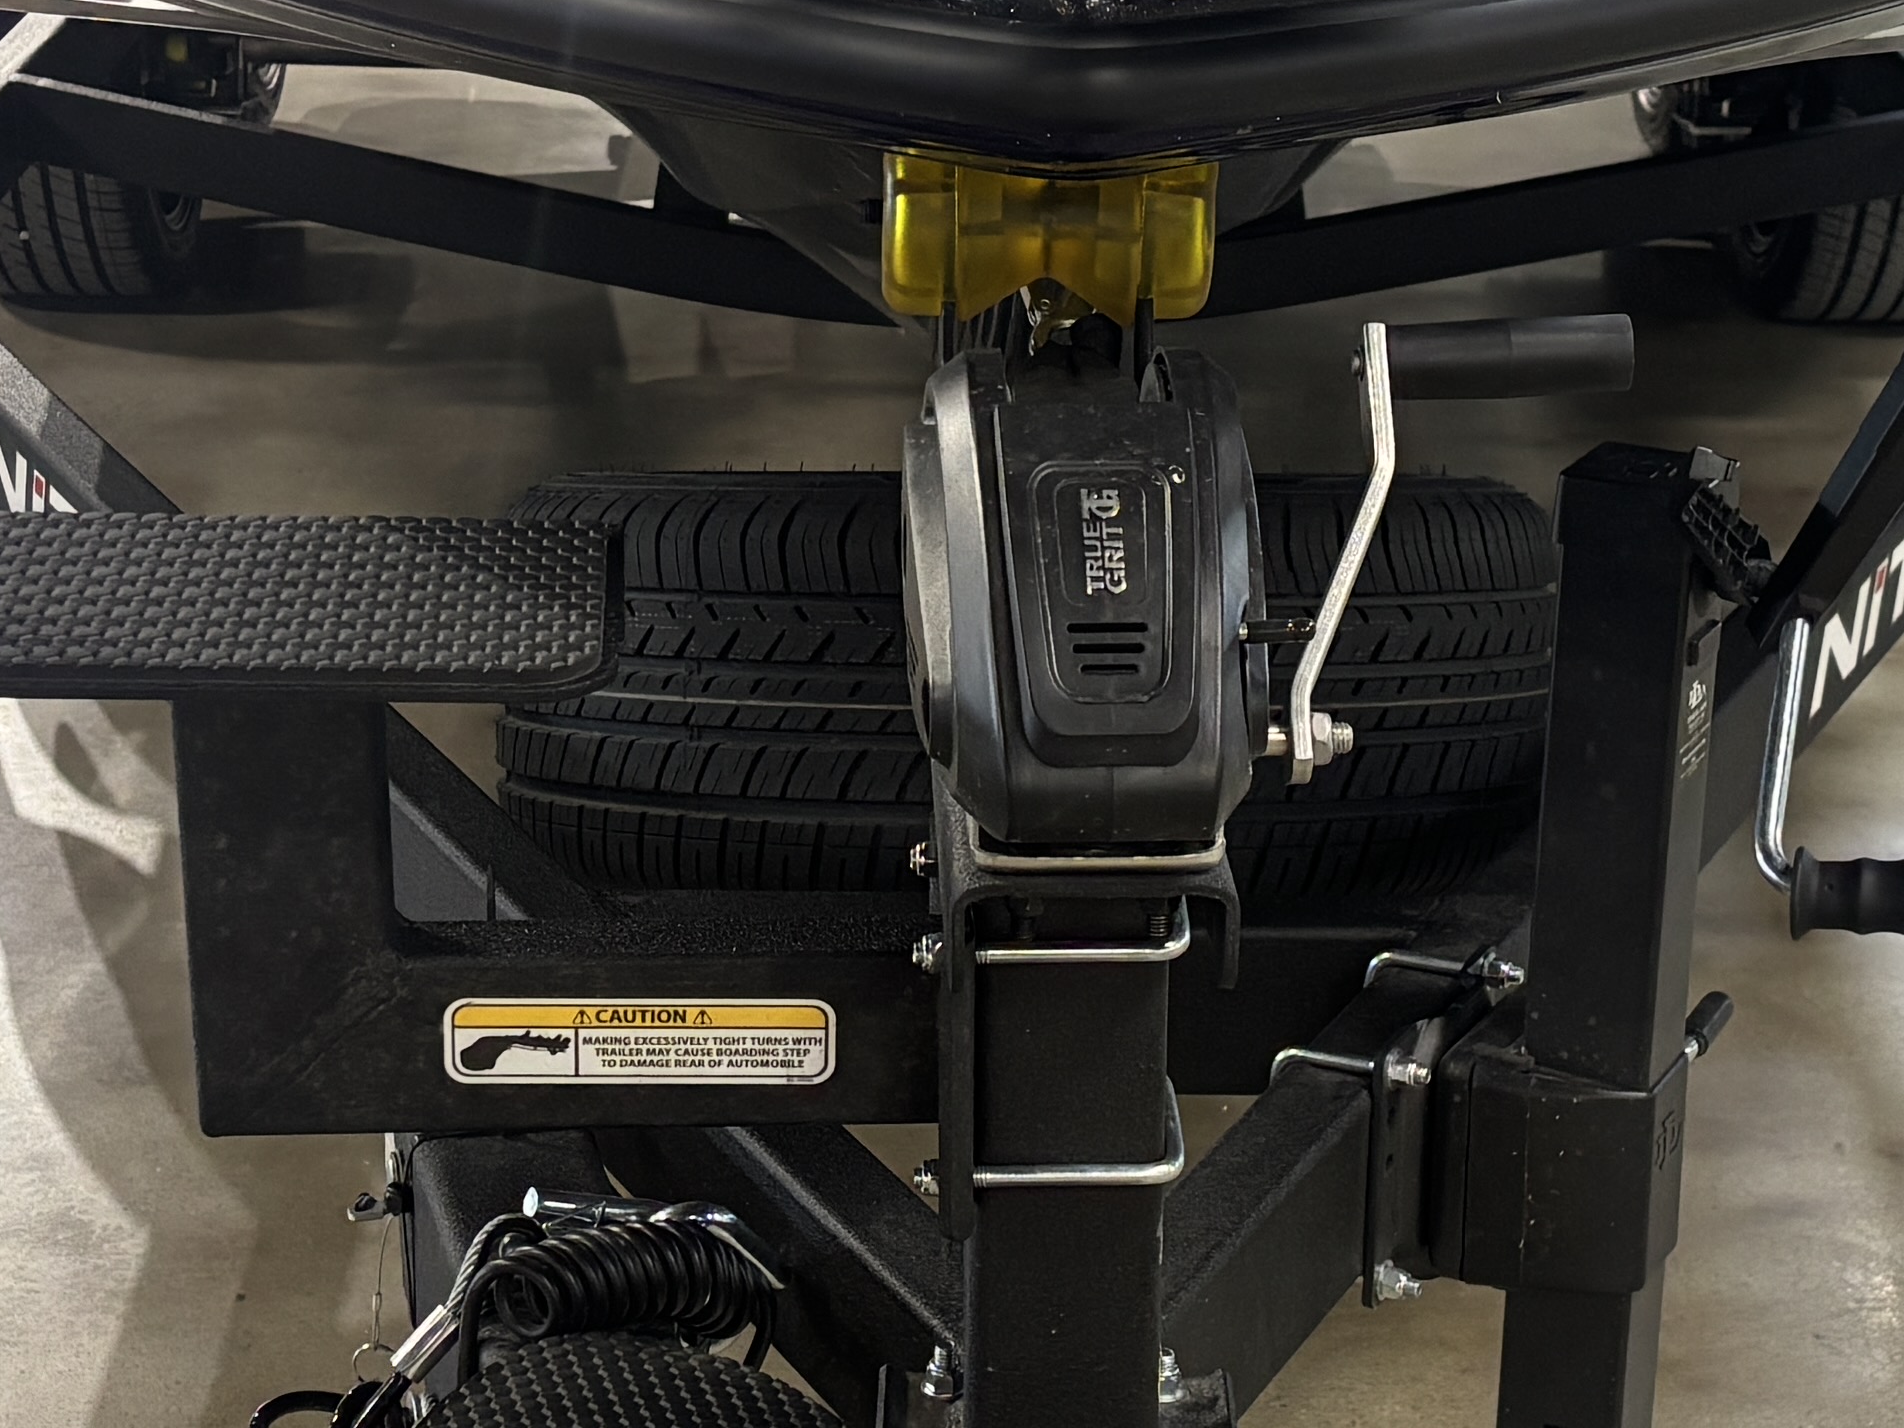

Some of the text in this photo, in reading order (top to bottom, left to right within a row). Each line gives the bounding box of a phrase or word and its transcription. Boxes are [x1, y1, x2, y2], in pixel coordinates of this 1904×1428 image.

[1082, 521, 1105, 595] TRUE
[1101, 521, 1127, 594] GRIT
[595, 1009, 687, 1024] CAUTION
[582, 1036, 823, 1046] MAKING EXCESSIVELY TIGHT TURNS WITH
[595, 1047, 811, 1057] TRAILER MAY CAUSE BOARDING STEP
[601, 1059, 805, 1068] TO DAMAGE REAR OF AUTOMOBILE
